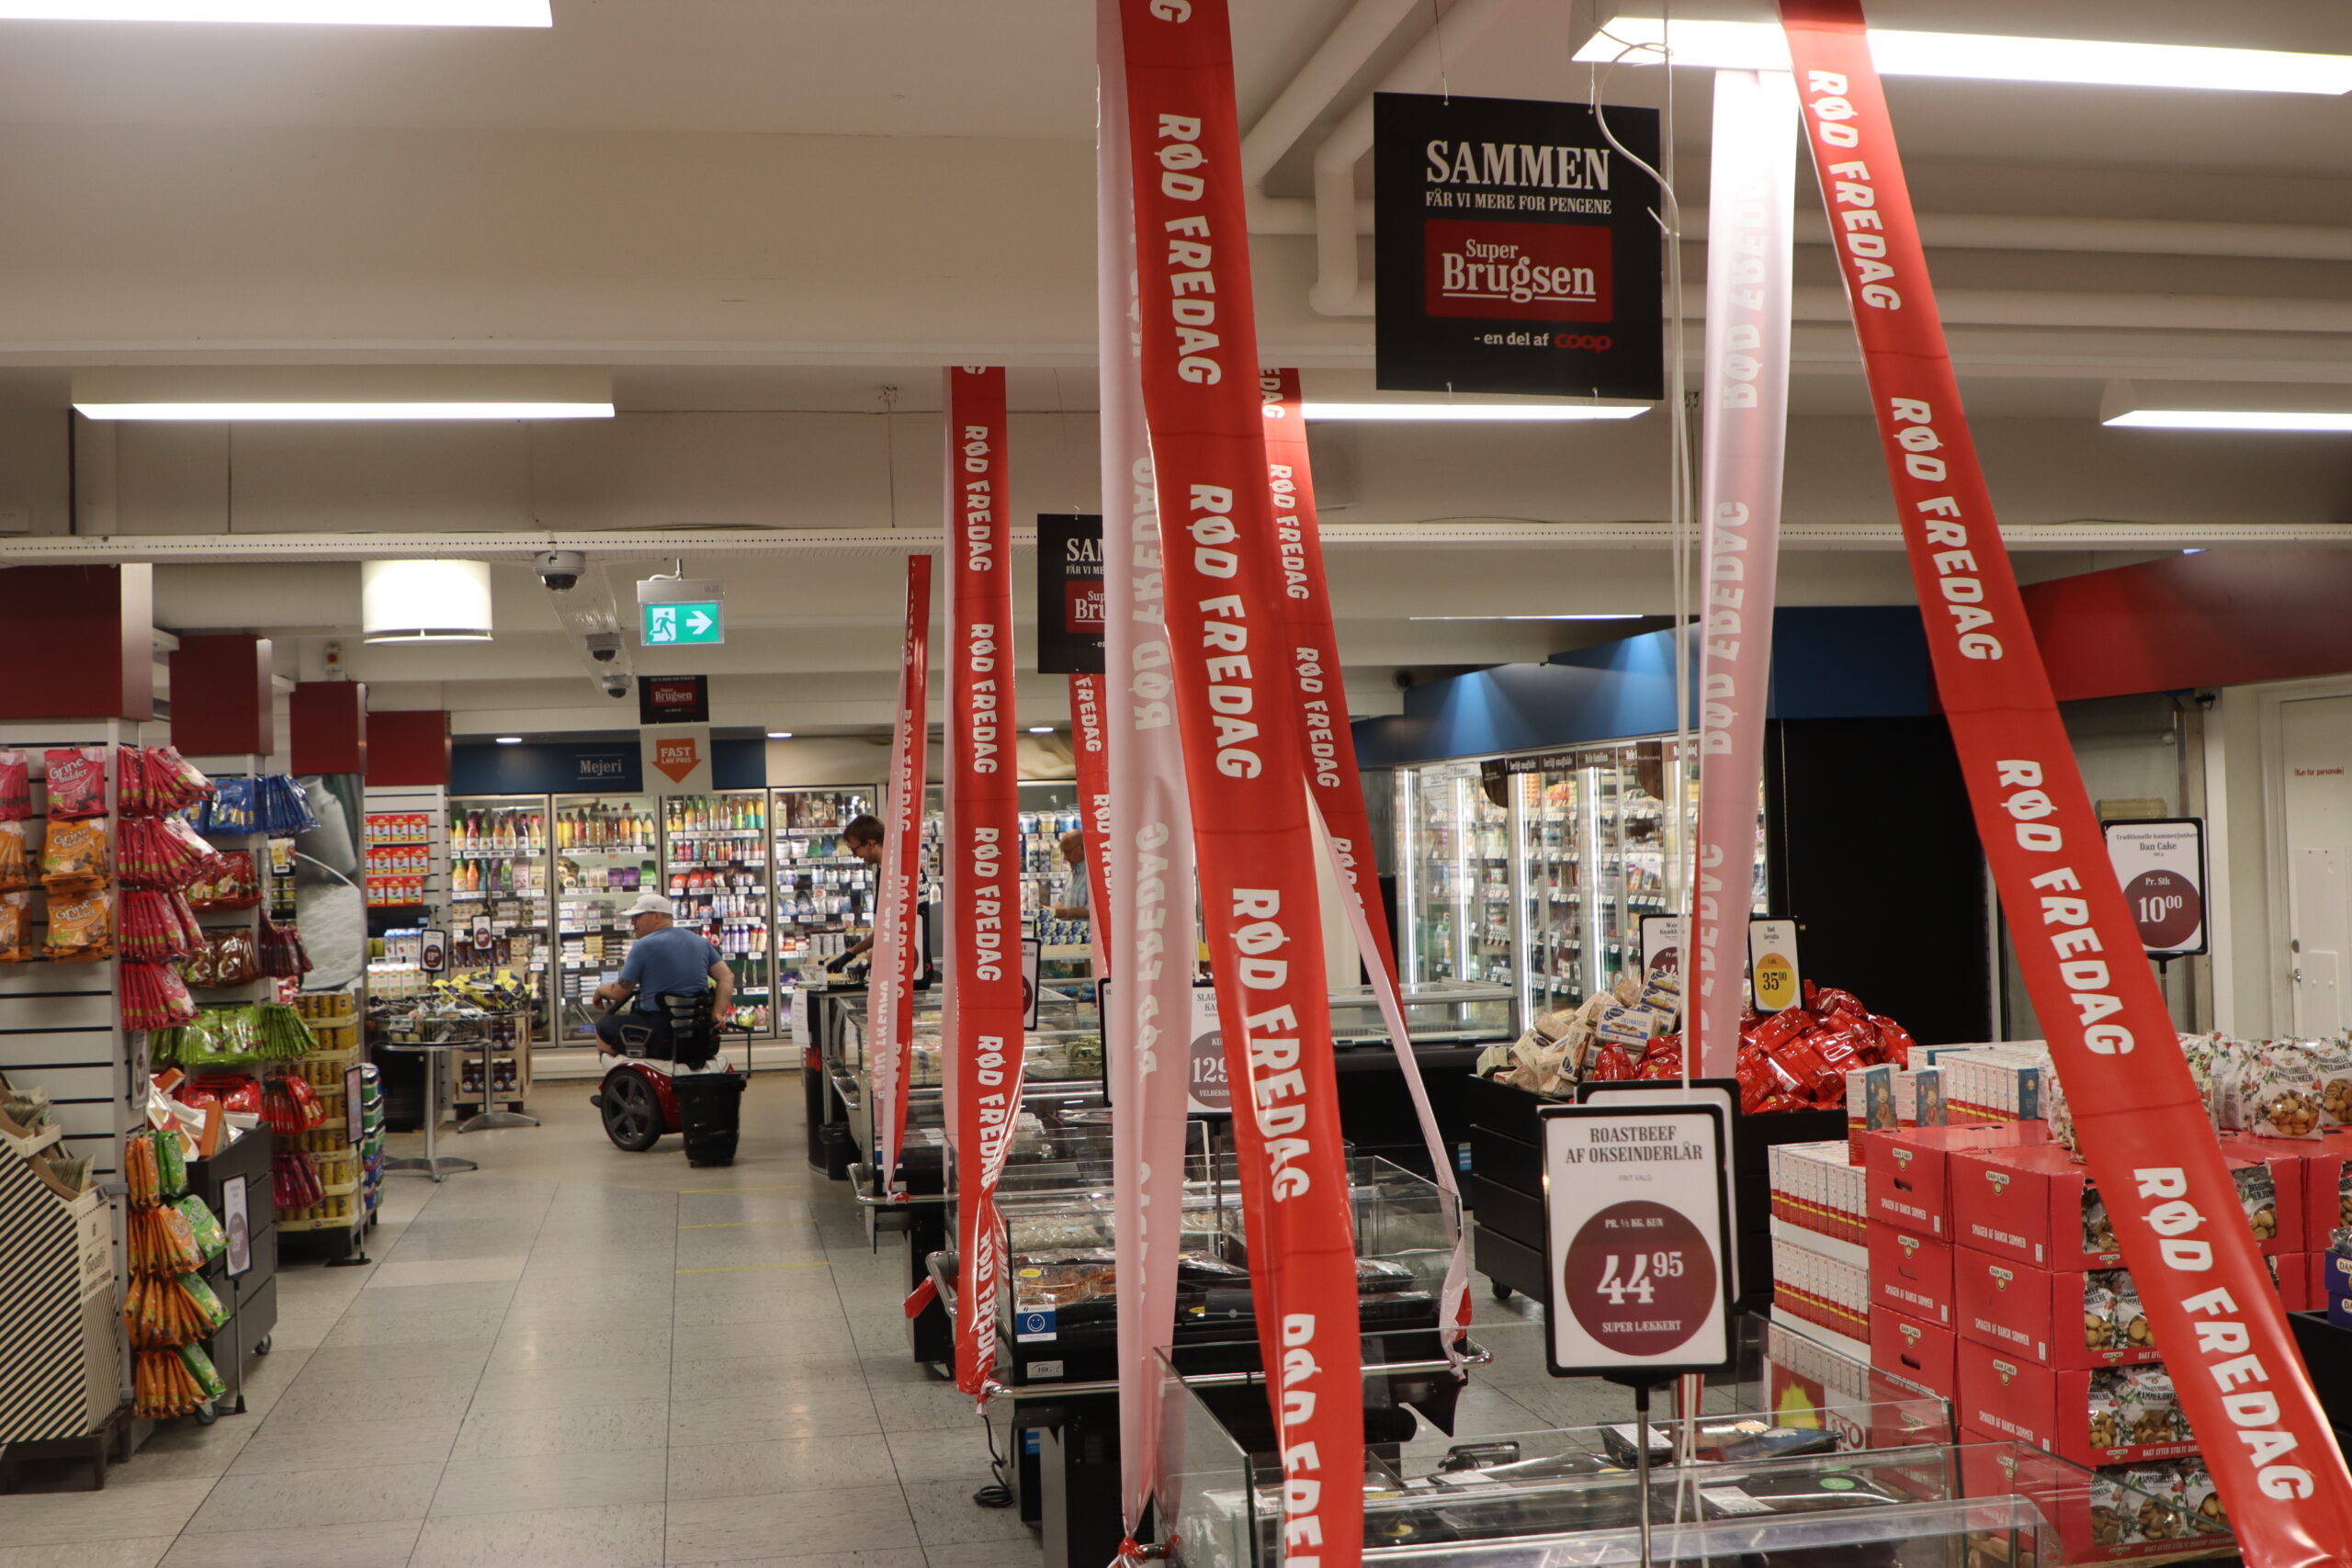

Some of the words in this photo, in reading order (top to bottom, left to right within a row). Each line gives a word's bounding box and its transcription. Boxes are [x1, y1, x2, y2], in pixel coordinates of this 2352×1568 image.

[1808, 69, 1859, 148] RØD
[1154, 113, 1208, 201] RØD
[1426, 140, 1610, 191] SAMMEN
[1426, 187, 1453, 208] FÅR
[1456, 192, 1471, 208] VI
[1475, 193, 1515, 210] MERE
[1519, 195, 1545, 211] FOR
[1549, 198, 1611, 215] PENGENE
[1465, 239, 1519, 263] Super
[1828, 160, 1901, 311] FREDAG
[1164, 215, 1222, 386] FREDAG
[1442, 253, 1597, 304] Brugsen
[1484, 332, 1504, 345] en
[1507, 332, 1531, 346] del
[1533, 333, 1550, 347] af
[1555, 333, 1611, 354] coop
[963, 425, 991, 473] RØD
[1891, 397, 1948, 483] RØD
[1269, 464, 1296, 509] RØD
[967, 479, 993, 571] FREDAG
[1186, 483, 1240, 579] RØD
[1276, 515, 1309, 600] FREDAG
[1917, 496, 2004, 661] FREDAG
[968, 624, 998, 672] RØD
[1295, 647, 1324, 694] RØD
[1075, 677, 1102, 752] FREDAG
[1199, 593, 1262, 779] FREDAG
[661, 747, 691, 757] FAST
[972, 680, 998, 773] FREDAG
[1304, 700, 1340, 787] FREDAG
[580, 759, 622, 775] Mejeri
[972, 827, 1002, 878] RØD
[2140, 842, 2155, 851] Dan
[2157, 841, 2177, 851] Cake
[975, 885, 1002, 982] FREDAG
[1229, 887, 1291, 991] RØD
[1996, 760, 2063, 852] RØD
[2030, 867, 2135, 1055] FREDAG
[975, 1035, 1006, 1086] RØD
[1246, 1003, 1311, 1203] FREDAG
[1589, 1125, 1677, 1143] ROASTBEEF
[1566, 1148, 1585, 1164] AF
[1589, 1141, 1702, 1164] OKSEINDERLÅR
[1605, 1219, 1619, 1228] PR.
[1602, 1321, 1634, 1333] SUPER
[1635, 1320, 1681, 1332] LÆKKERT
[2133, 1167, 2213, 1272] RØD
[2181, 1287, 2314, 1501] FREDAG
